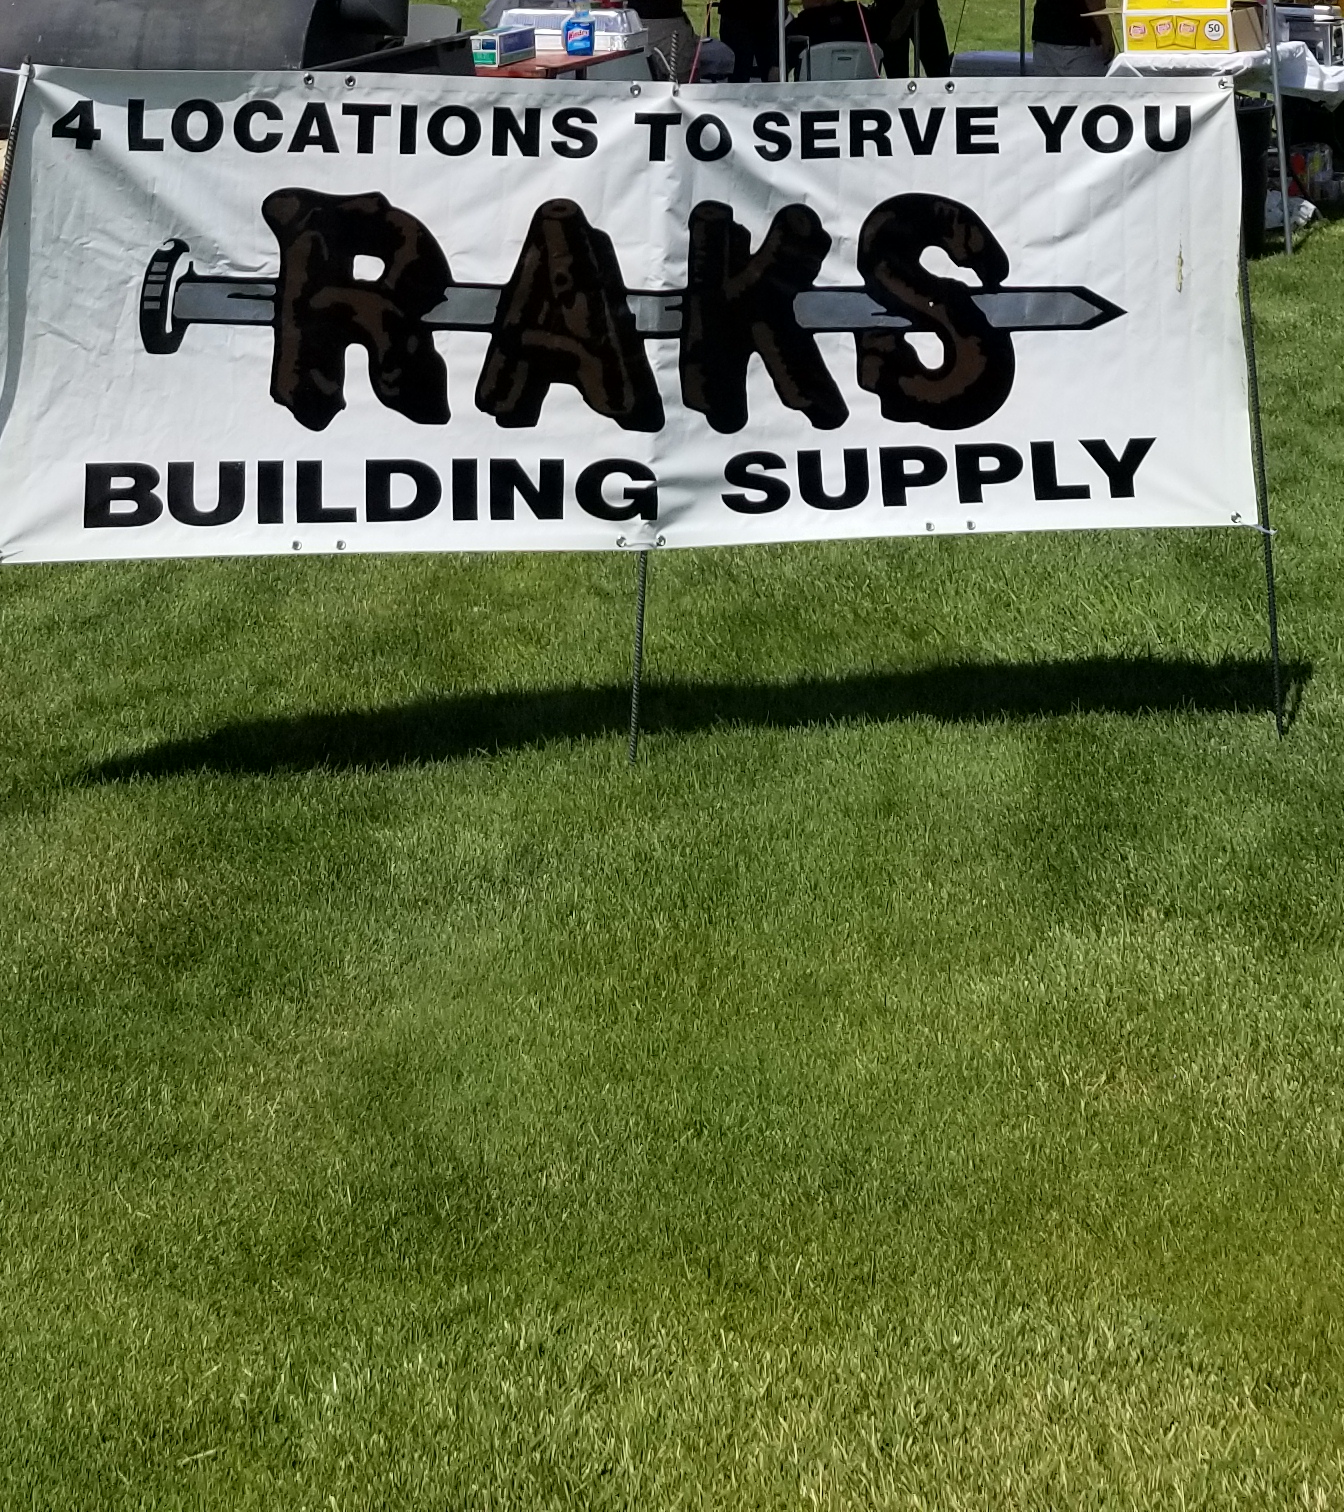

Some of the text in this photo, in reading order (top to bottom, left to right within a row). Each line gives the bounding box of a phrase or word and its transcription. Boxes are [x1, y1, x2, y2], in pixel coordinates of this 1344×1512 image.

[1208, 23, 1220, 33] 50
[53, 98, 1192, 162] 4 LOCATIONS TO SERVE YOU
[261, 186, 1016, 435] RAKS
[83, 437, 1157, 529] BUILDING SUPPLY
